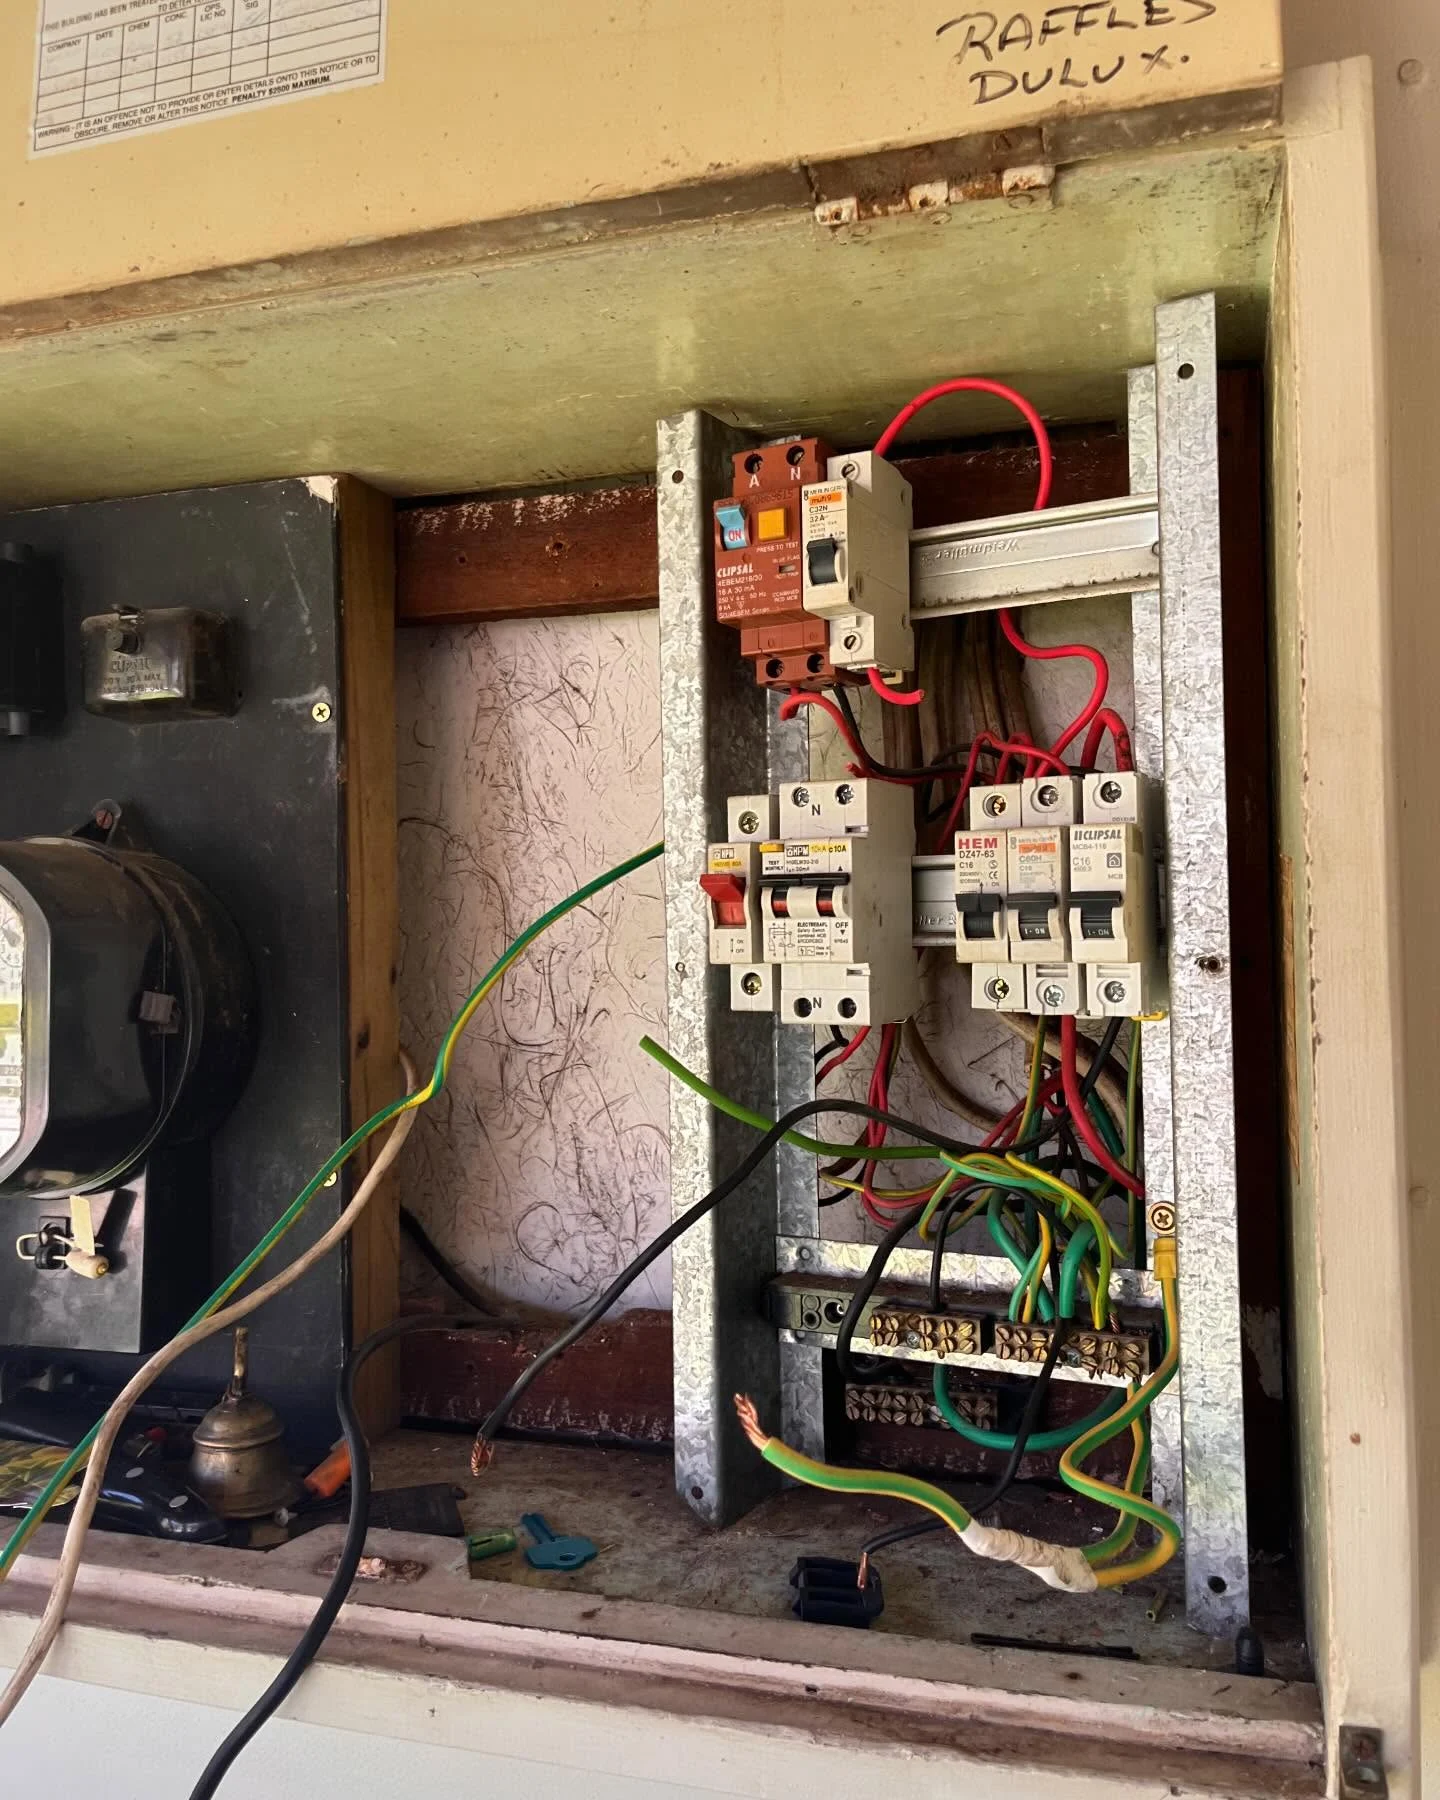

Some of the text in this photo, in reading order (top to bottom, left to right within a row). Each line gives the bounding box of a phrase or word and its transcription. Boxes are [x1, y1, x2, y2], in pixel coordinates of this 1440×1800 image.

[61, 12, 92, 28] BUILDING
[94, 8, 108, 19] HAS
[110, 4, 127, 15] BEEN
[215, 9, 226, 17] NO
[128, 20, 150, 32] CHEM
[95, 30, 113, 40] DATE
[47, 39, 81, 53] COMPANY
[38, 125, 70, 138] WARNING
[104, 109, 138, 122] OFFENCE
[140, 105, 155, 114] NOT
[169, 94, 201, 108] PROVIDE
[203, 91, 214, 100] OR
[216, 86, 242, 97] ENTER
[243, 78, 274, 91] DETAILS
[276, 73, 298, 84] ONTO
[300, 69, 317, 79] THIS
[320, 62, 348, 74] NOTICE
[350, 58, 362, 67] OR
[365, 55, 375, 63] TO
[112, 117, 143, 129] REMOVE
[145, 114, 155, 123] OR
[158, 108, 180, 120] ALTER
[182, 104, 199, 114] THIS
[232, 90, 267, 103] PENALTY
[268, 84, 290, 96] $2500
[790, 467, 801, 480] N
[749, 474, 760, 488] A
[728, 529, 742, 541] ON
[716, 562, 754, 578] CLIPSAL
[811, 804, 821, 815] N
[1083, 829, 1122, 840] CLIPSAL
[958, 838, 998, 849] HEM
[793, 845, 809, 857] HPM
[959, 850, 995, 858] DZ47-63
[1072, 857, 1091, 866] C16
[813, 997, 822, 1008] N
